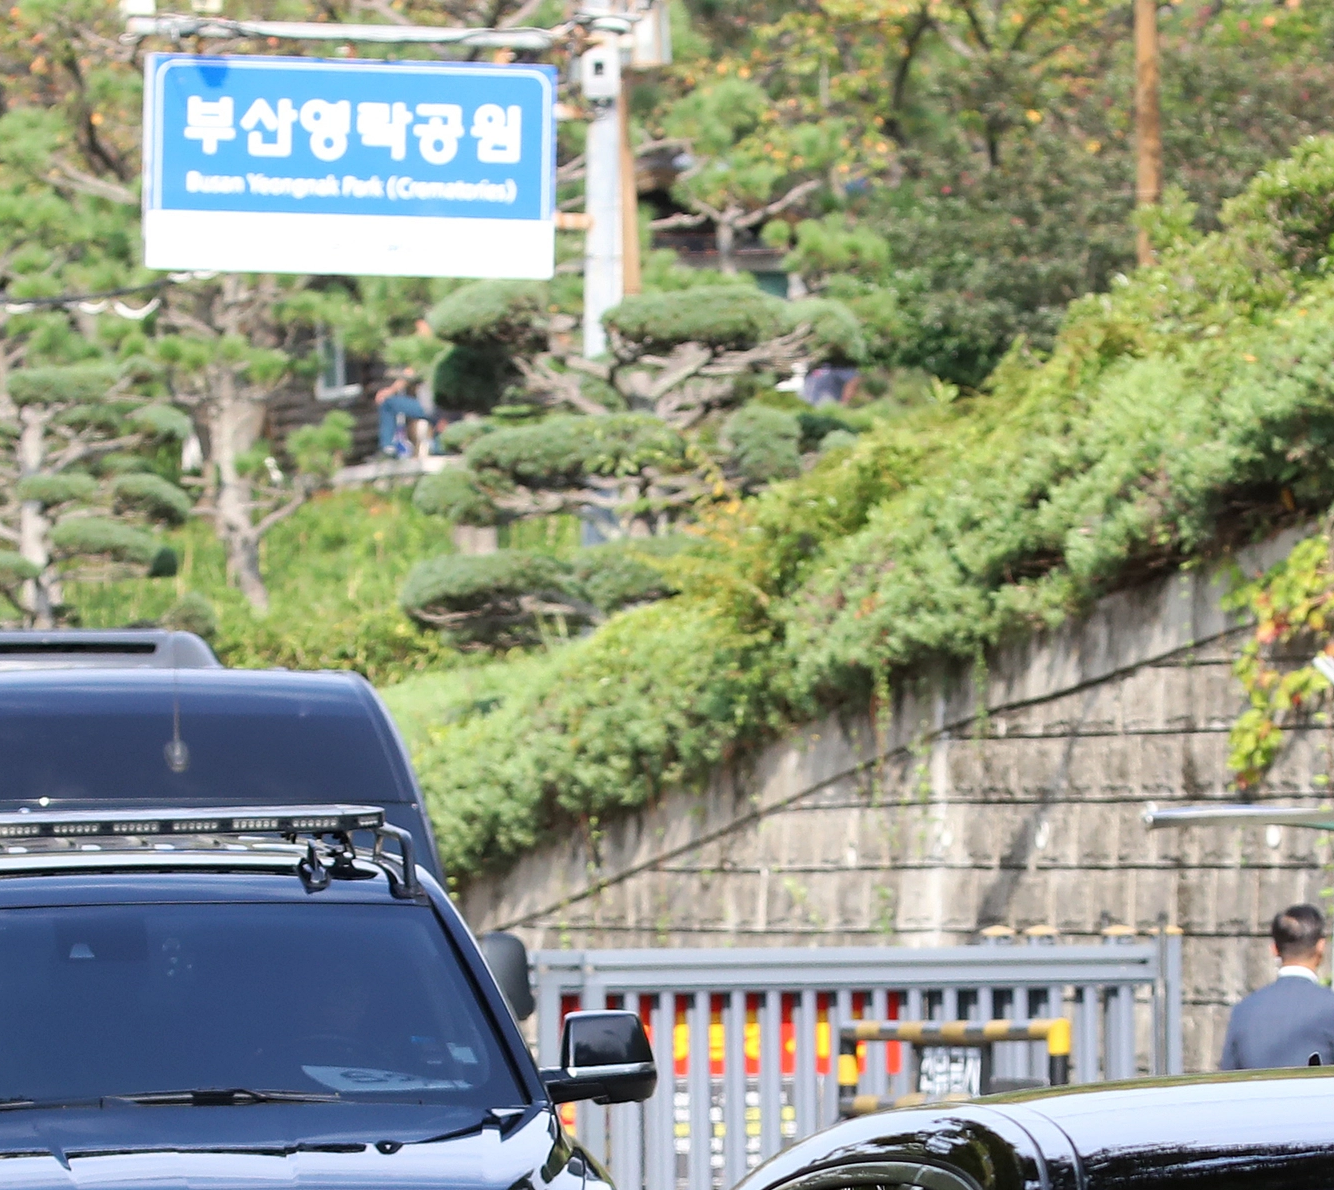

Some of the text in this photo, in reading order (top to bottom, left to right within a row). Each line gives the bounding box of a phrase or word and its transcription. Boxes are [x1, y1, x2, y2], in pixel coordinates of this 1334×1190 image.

[183, 95, 522, 165] 부산영락공원
[185, 170, 245, 193] Busan
[246, 172, 340, 199] Yeongnak
[341, 175, 385, 198] Park
